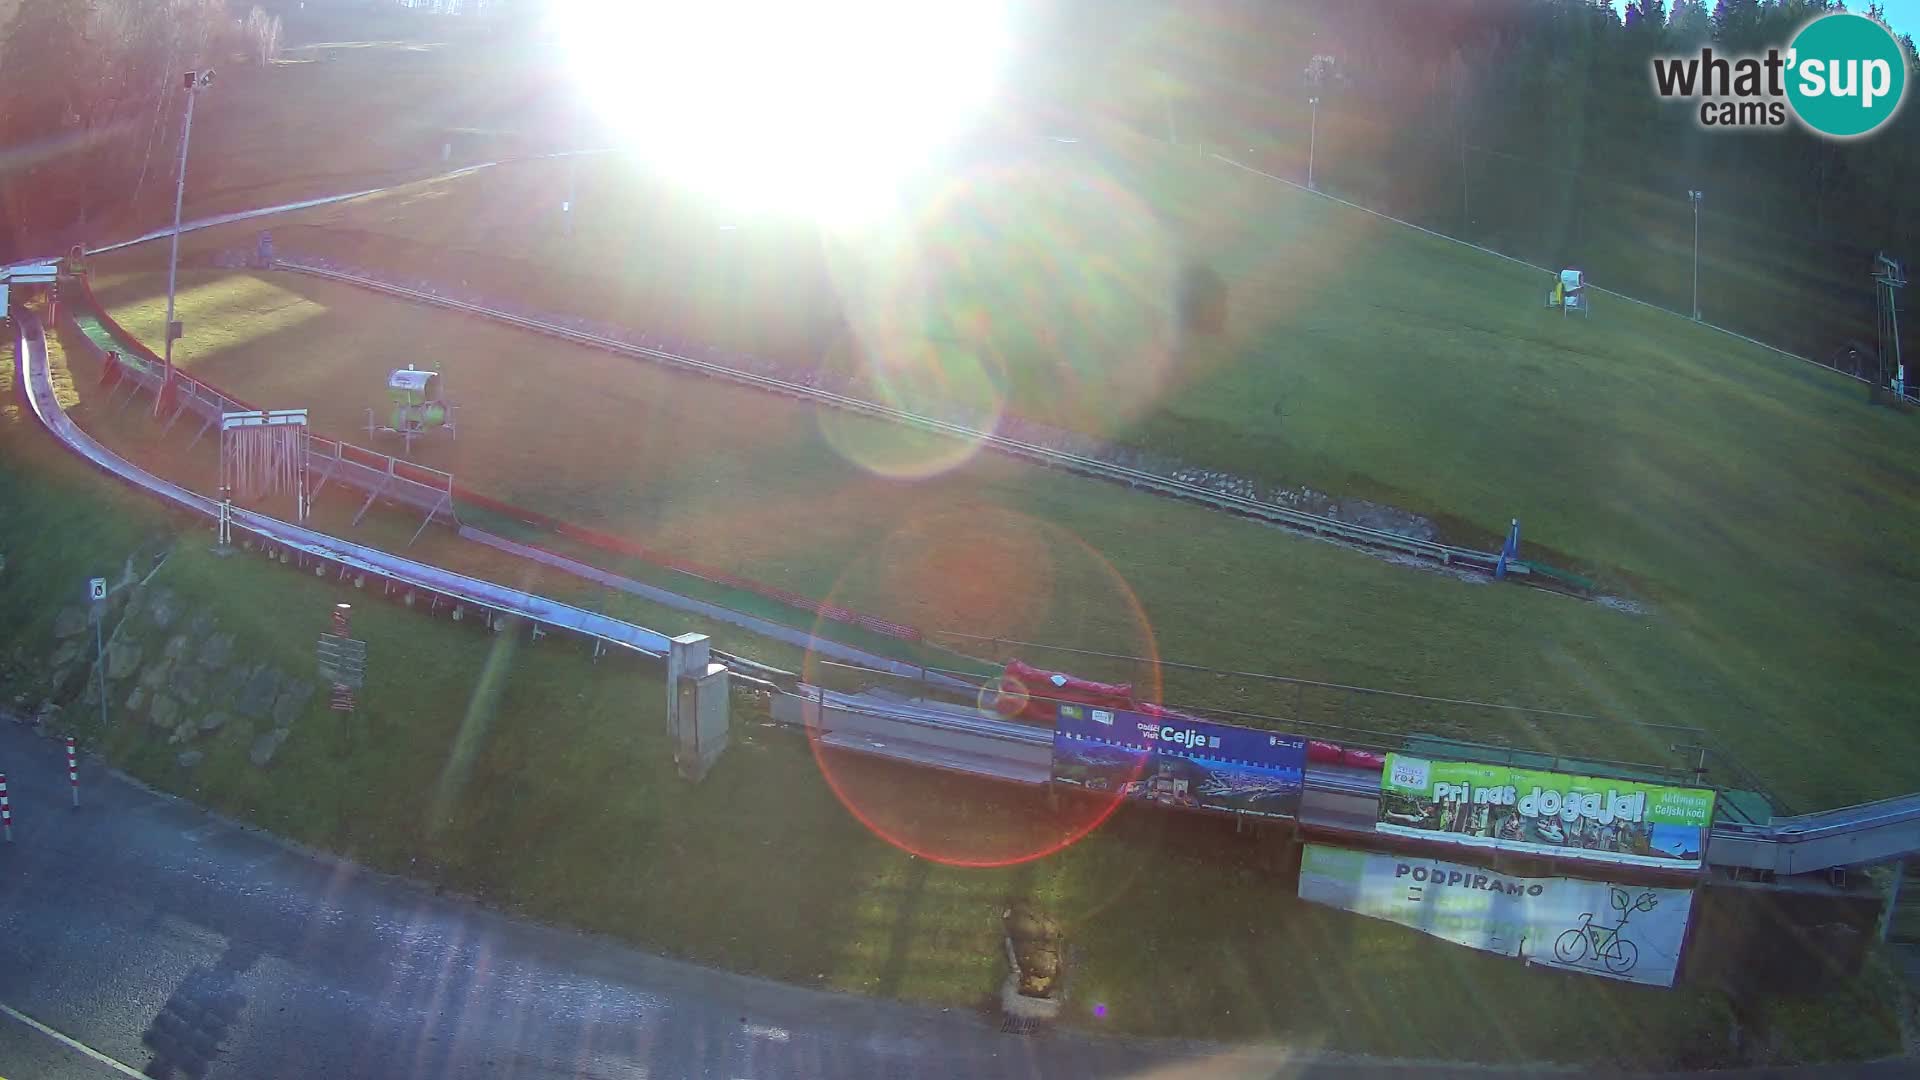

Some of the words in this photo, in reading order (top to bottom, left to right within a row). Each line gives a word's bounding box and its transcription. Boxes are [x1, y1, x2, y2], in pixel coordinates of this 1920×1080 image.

[1161, 726, 1206, 749] Celje
[1432, 781, 1469, 804] Pri
[1474, 785, 1516, 806] nas
[1517, 786, 1646, 825] dogaja!
[1395, 863, 1544, 897] PODPIRAMO
